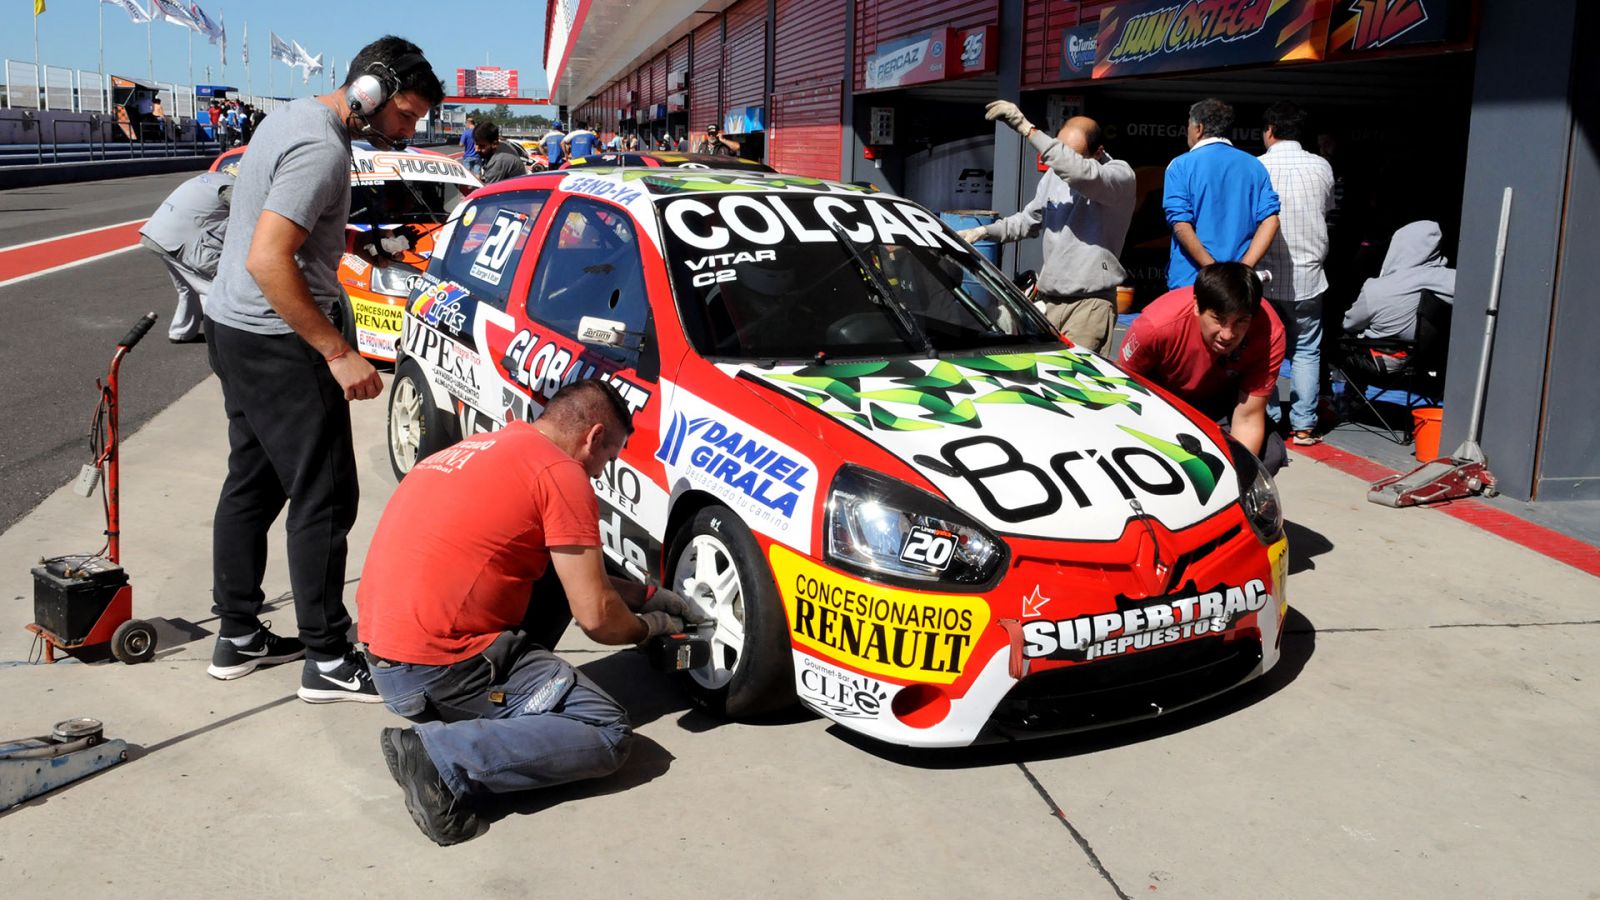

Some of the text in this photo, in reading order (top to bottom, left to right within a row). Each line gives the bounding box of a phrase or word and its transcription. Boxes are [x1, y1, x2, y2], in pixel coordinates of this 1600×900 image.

[960, 32, 984, 61] 35
[1113, 0, 1273, 57] JUAN ORTEGA
[1127, 122, 1188, 138] ORTEGA
[664, 194, 969, 254] COLCAR
[475, 214, 523, 271] 20
[684, 249, 777, 271] VITAR
[692, 269, 737, 288] C2
[355, 313, 403, 332] RENAU
[356, 303, 402, 320] CONCESIONA
[701, 421, 809, 492] DANIEL
[595, 480, 637, 516] OTEL
[690, 445, 799, 519] GIRALA
[749, 504, 789, 531] camino
[903, 531, 953, 566] 20
[796, 573, 973, 632] CONCESIONARIOS
[1022, 578, 1268, 658] SUPERTRAC
[794, 595, 970, 674] RENAULT
[1086, 617, 1227, 660] REPUESTOS
[804, 657, 850, 682] Gourmet-Bar
